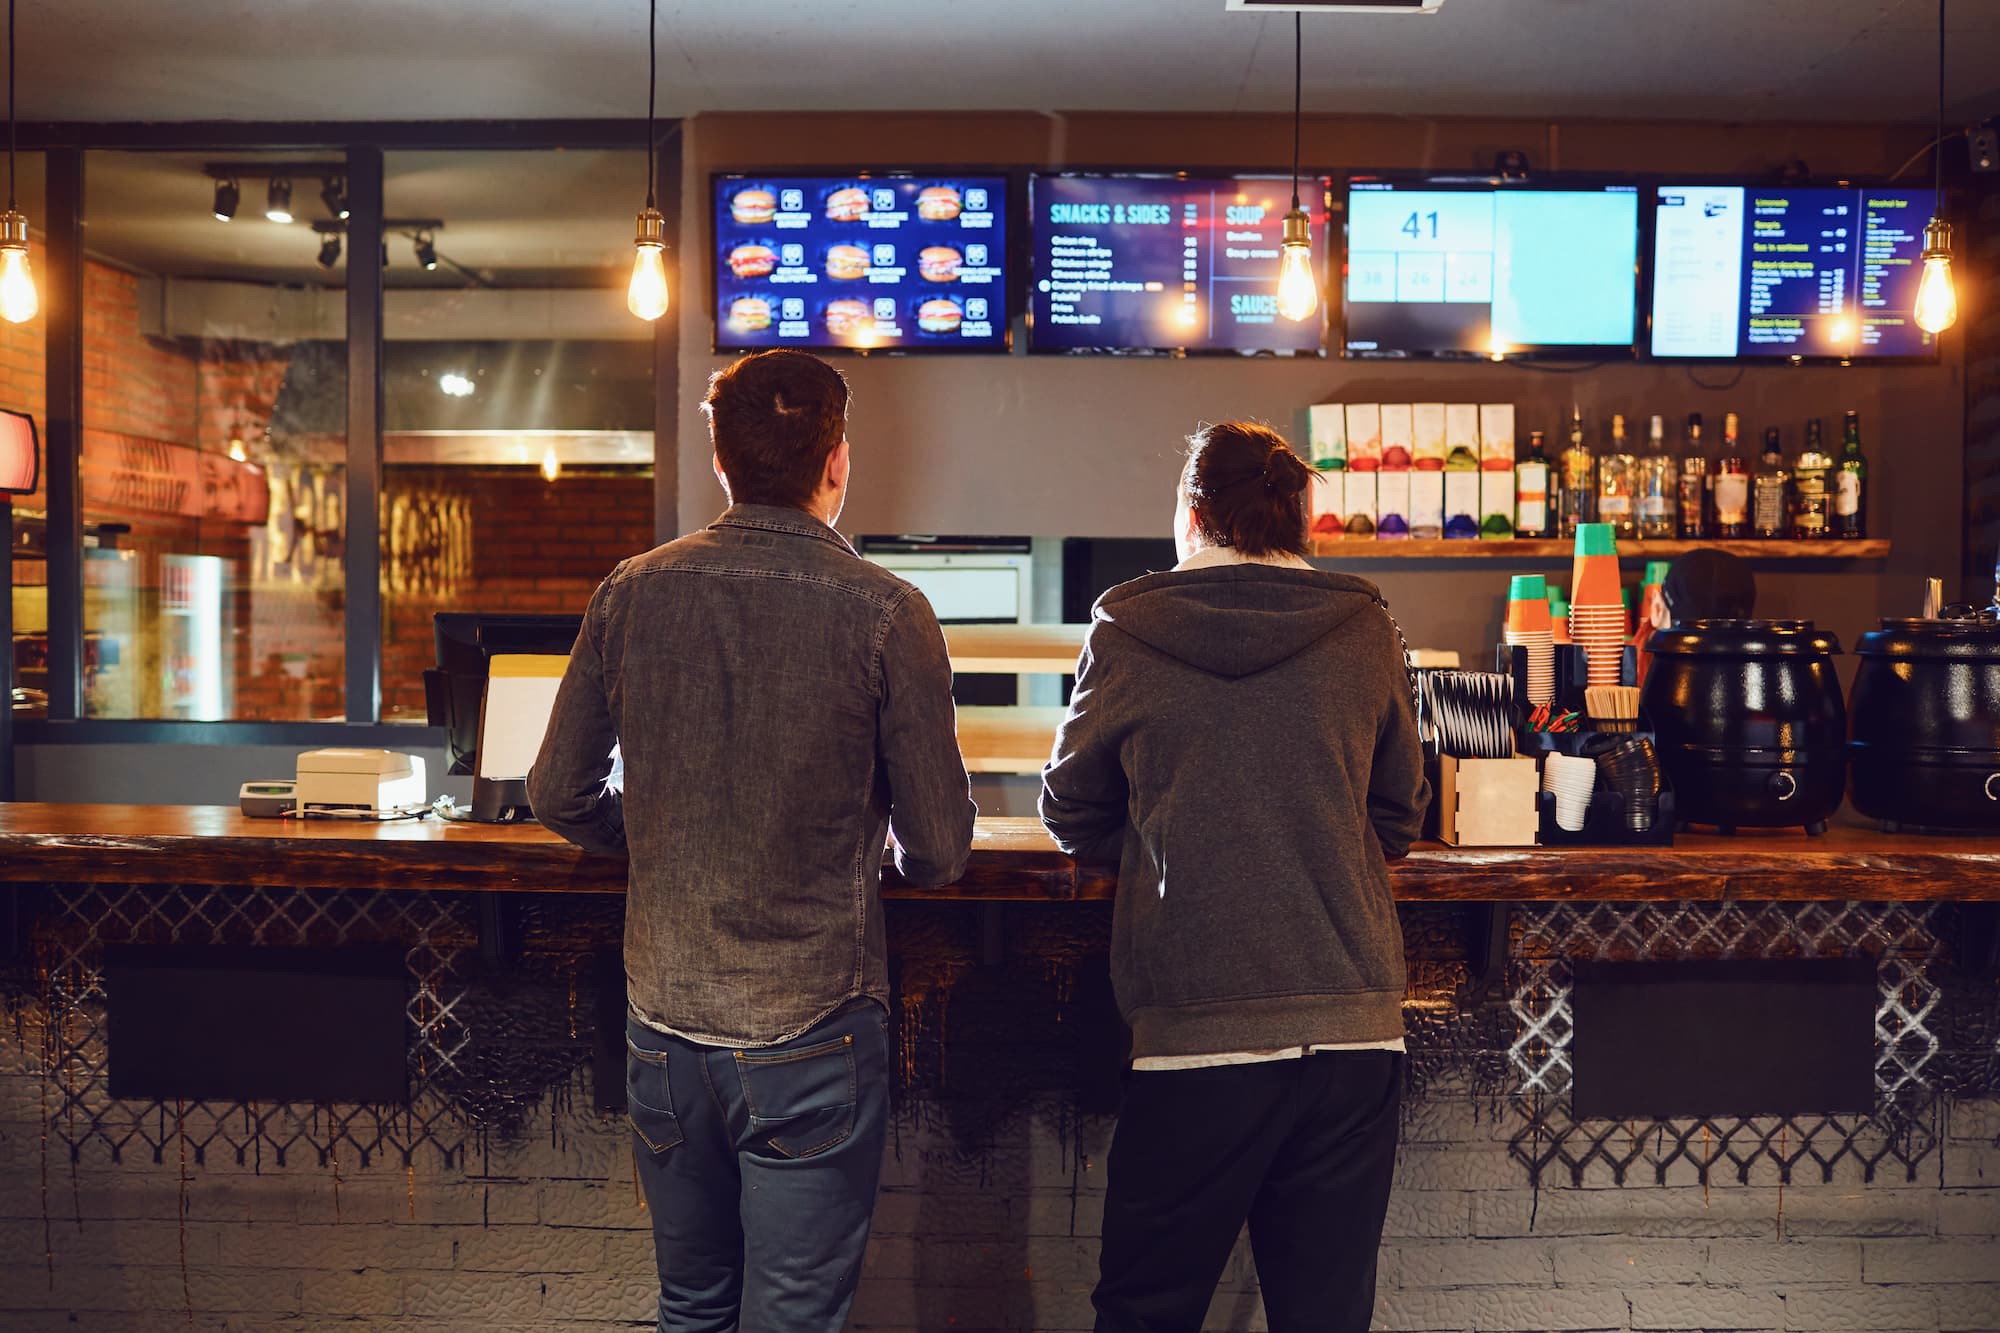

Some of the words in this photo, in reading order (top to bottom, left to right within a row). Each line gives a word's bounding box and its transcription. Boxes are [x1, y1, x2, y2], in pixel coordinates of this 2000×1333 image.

[1050, 204, 1111, 224] SNACKS
[1112, 205, 1127, 224] &
[1127, 205, 1171, 225] SIDES
[1226, 206, 1265, 225] SOUP
[1401, 211, 1438, 239] 41
